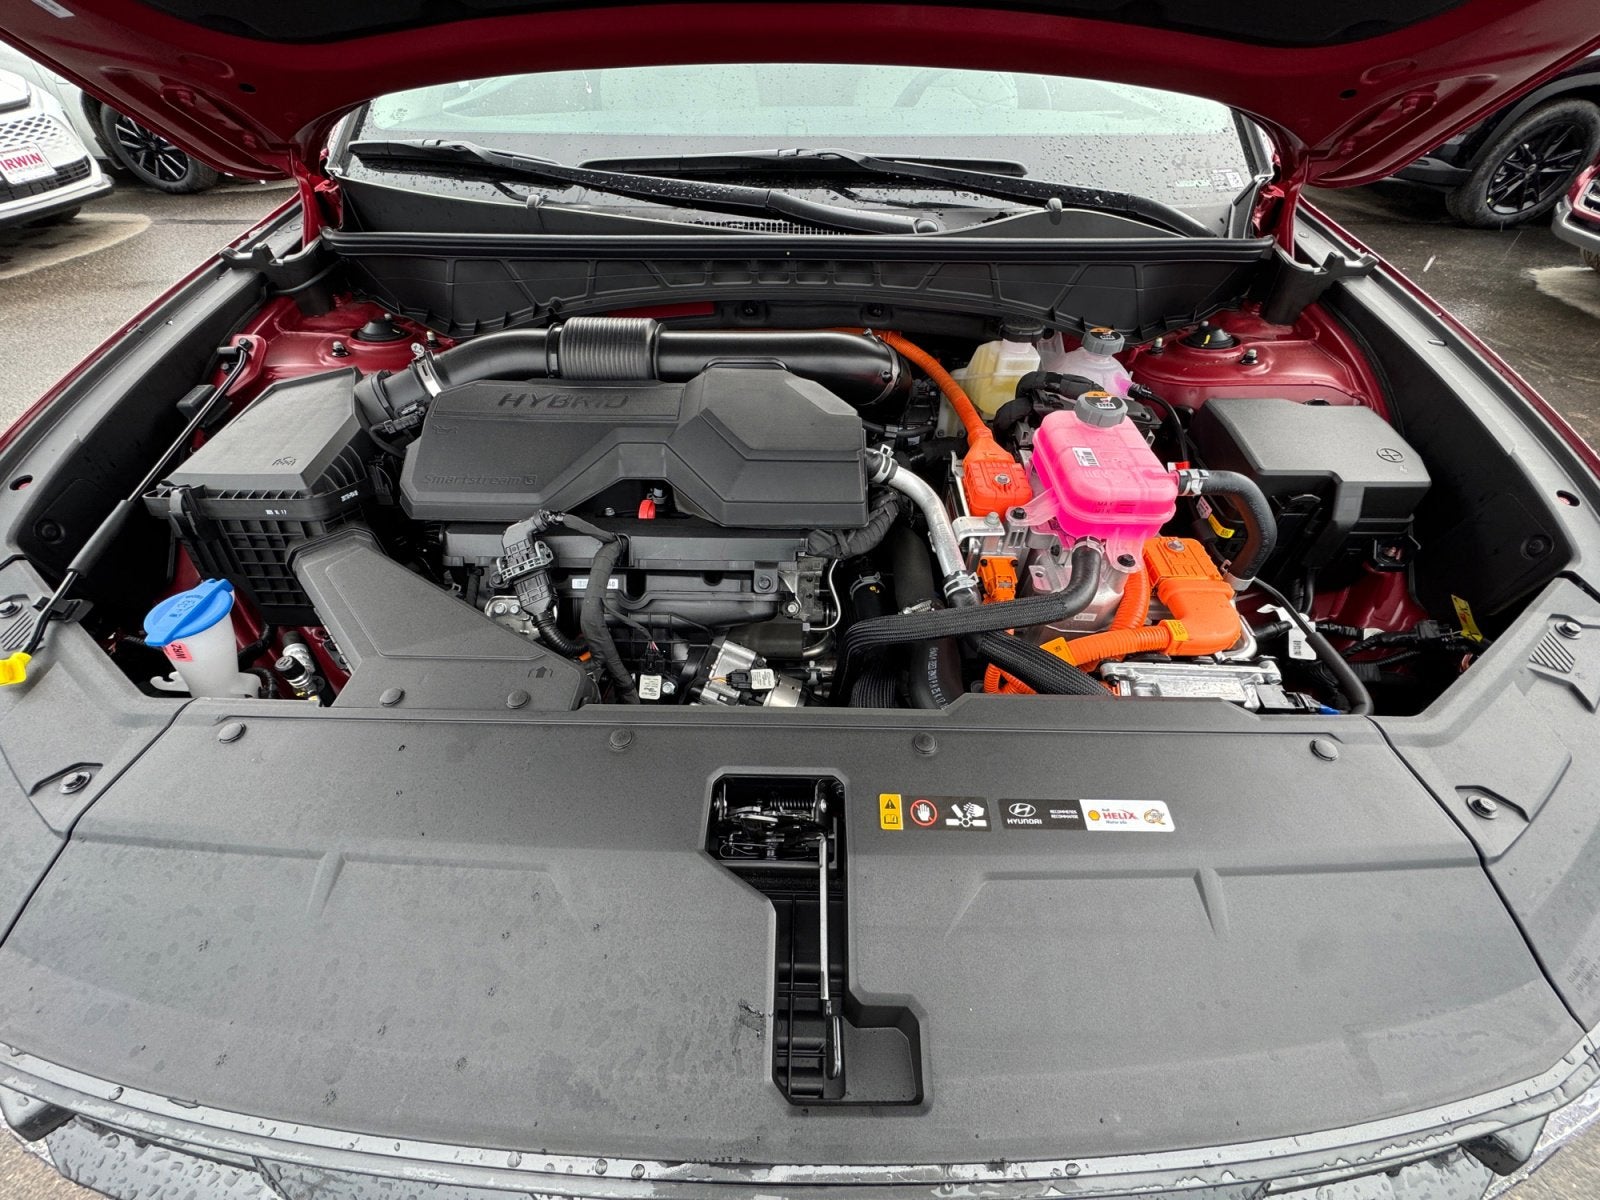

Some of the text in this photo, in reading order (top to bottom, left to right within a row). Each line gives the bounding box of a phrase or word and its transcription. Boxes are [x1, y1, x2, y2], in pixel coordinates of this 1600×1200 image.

[0, 153, 43, 171] IRWIN
[497, 392, 629, 409] HYBRID
[423, 473, 520, 486] Smartstream
[1102, 812, 1137, 820] HELIX
